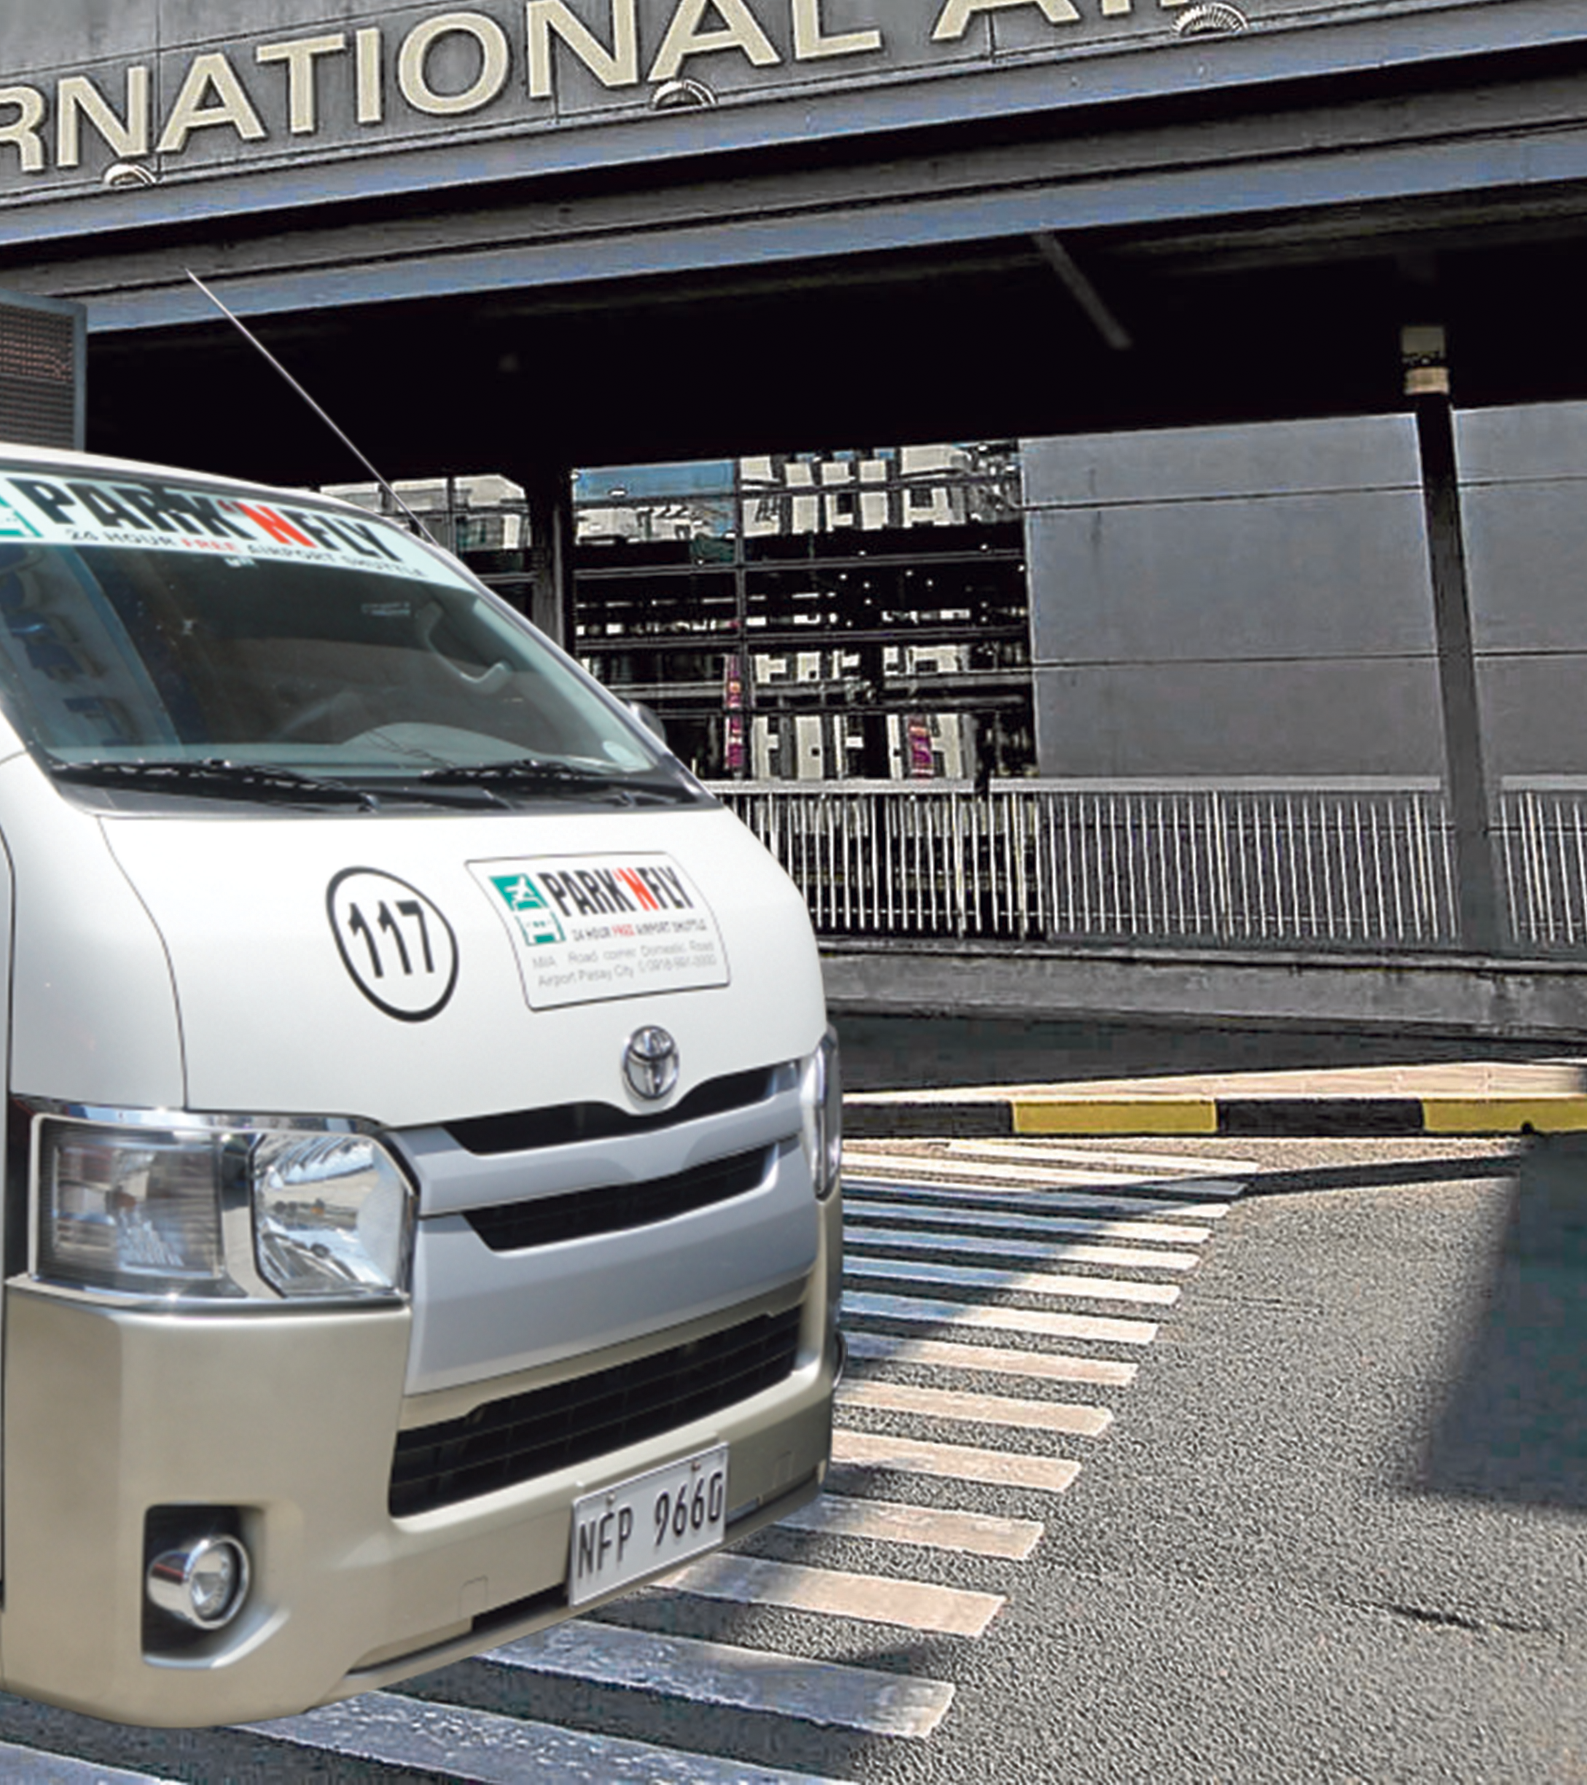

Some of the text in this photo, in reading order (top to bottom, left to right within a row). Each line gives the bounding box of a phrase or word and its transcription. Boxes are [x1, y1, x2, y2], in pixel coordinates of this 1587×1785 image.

[348, 899, 434, 978] 117
[578, 1470, 723, 1579] NFP 9660
